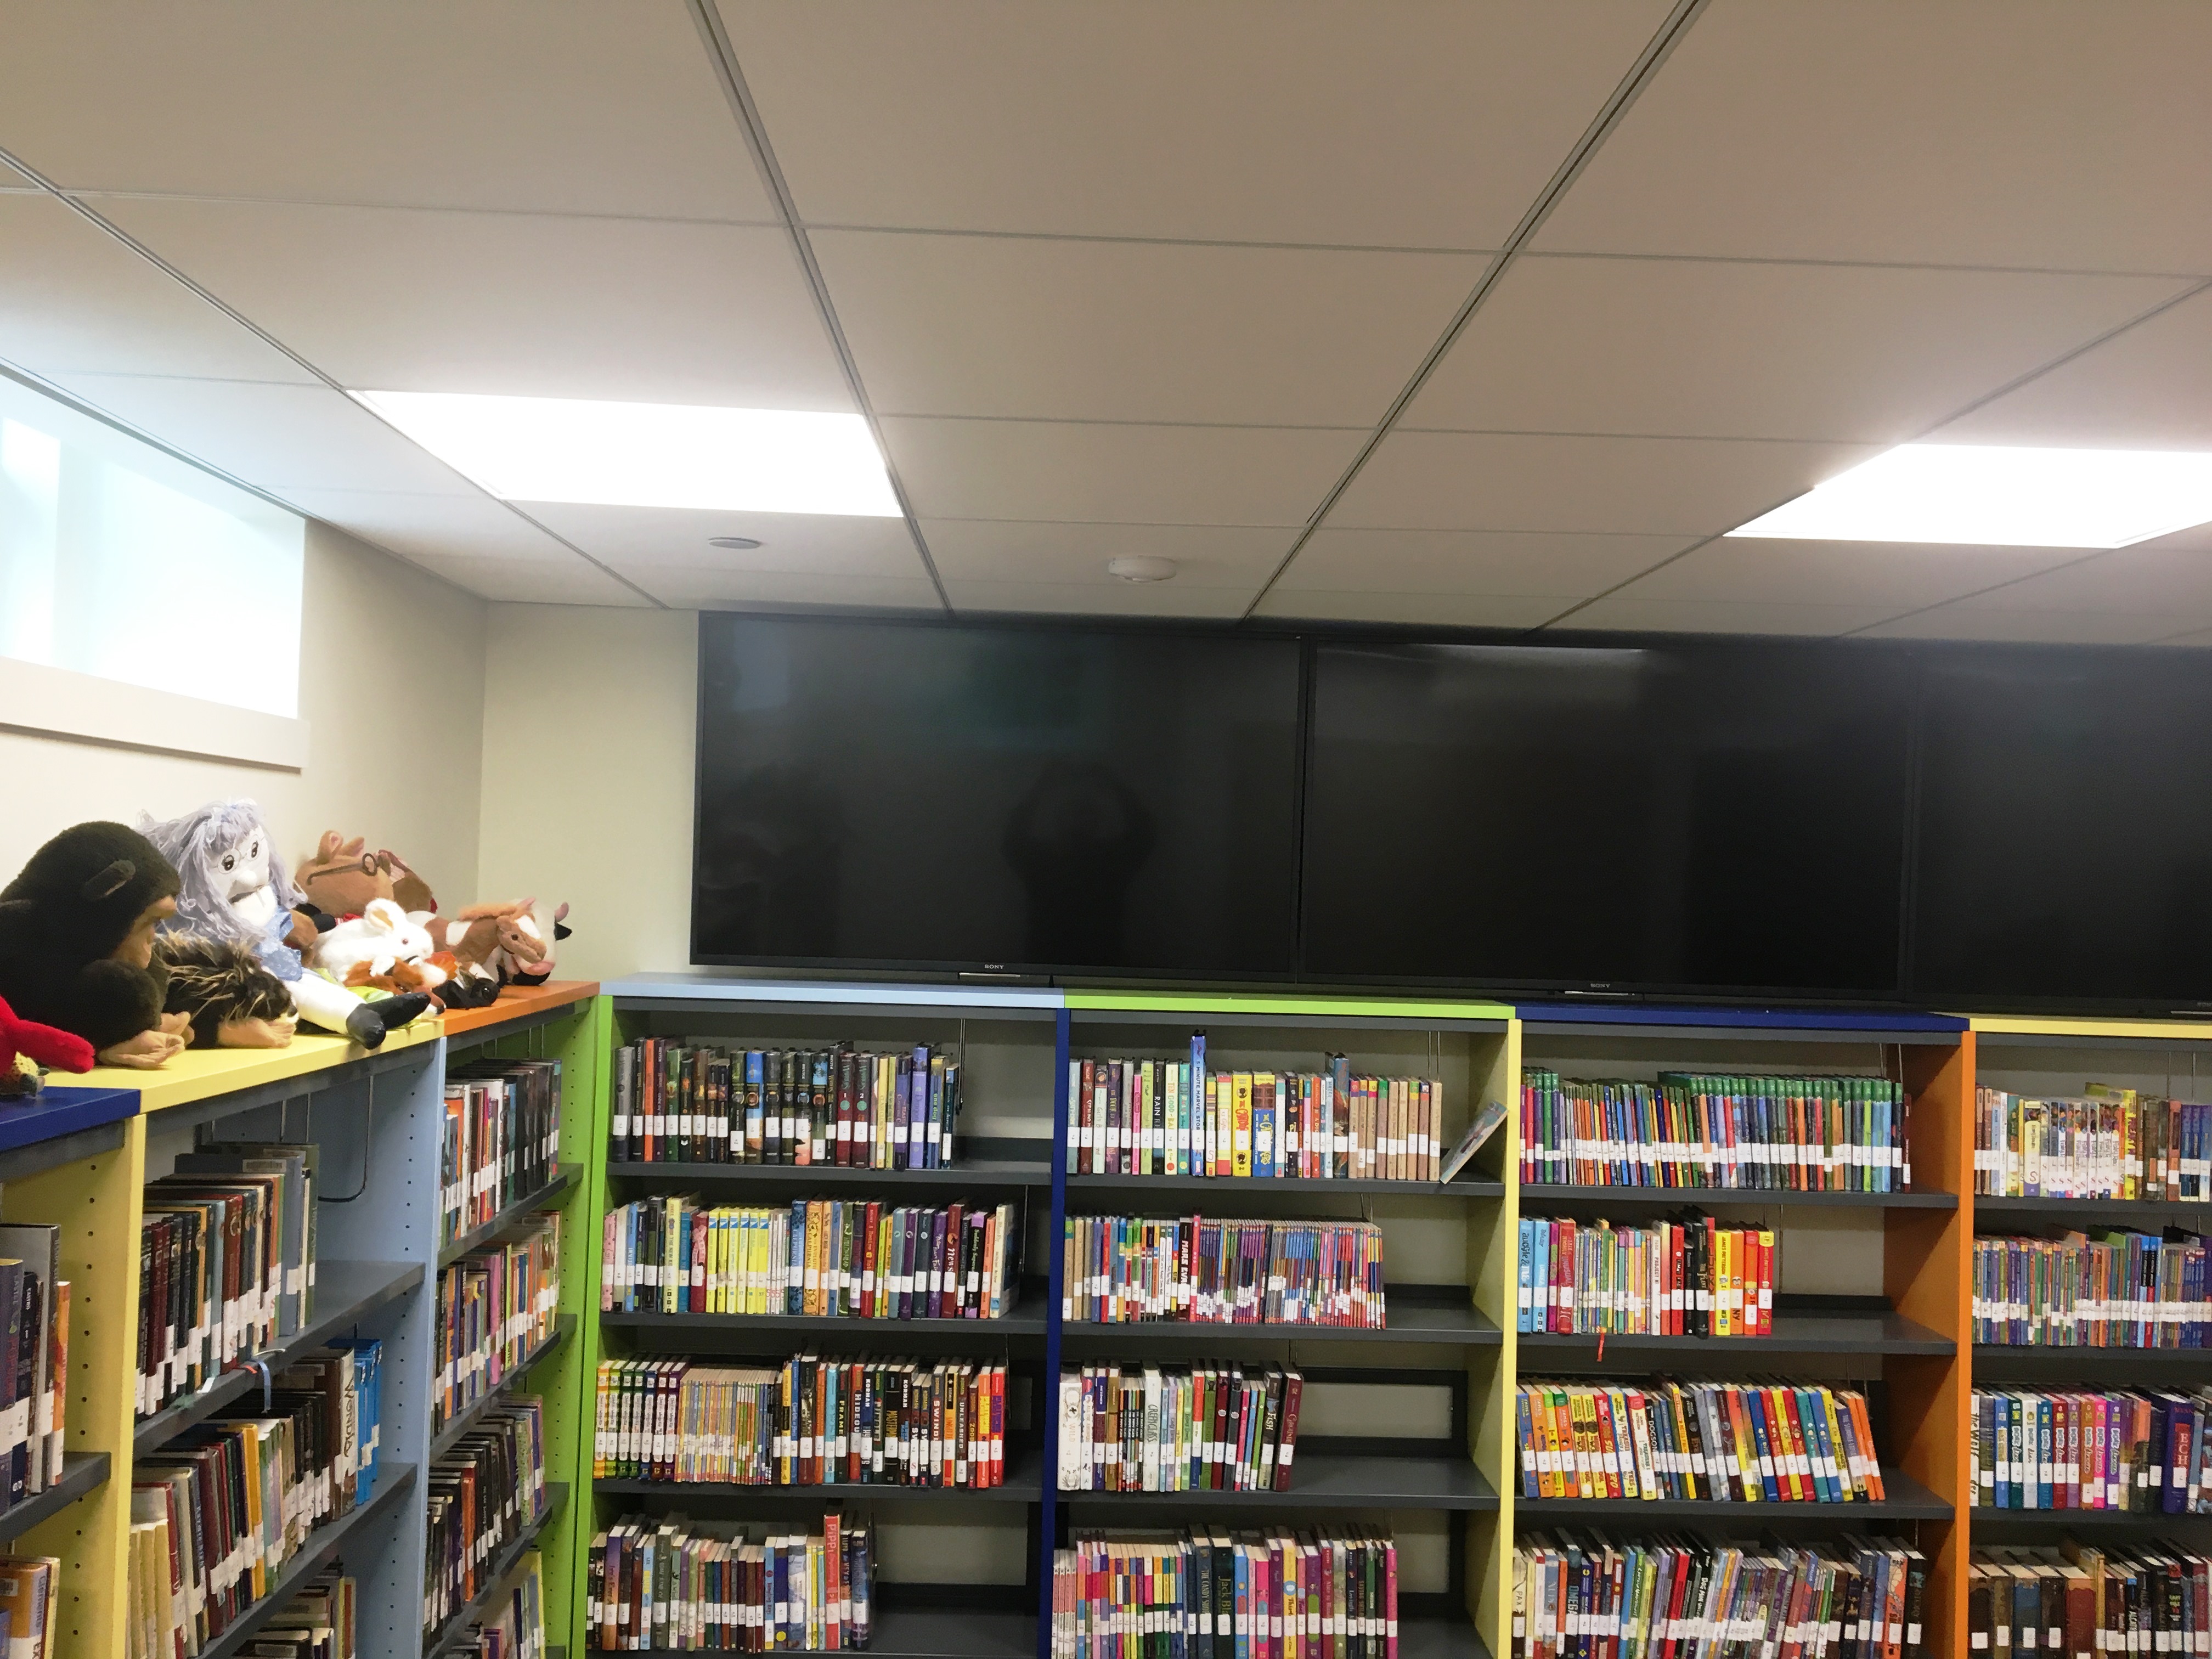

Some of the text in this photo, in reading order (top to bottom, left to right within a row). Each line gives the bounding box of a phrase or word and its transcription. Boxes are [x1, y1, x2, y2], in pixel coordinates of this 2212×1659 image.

[947, 1248, 956, 1272] News
[343, 1378, 356, 1458] WONDLA
[854, 1393, 862, 1432] HIDEOU
[885, 1410, 898, 1437] MASTERM
[1266, 1412, 1277, 1431] FISH
[1068, 1422, 1076, 1442] WILD
[1647, 1420, 1658, 1452] DOGSON
[1970, 1413, 1979, 1458] the Wolf
[1201, 1570, 1210, 1615] THE CANDY SHOP
[1218, 1576, 1231, 1615] Jack Bla
[1567, 1585, 1579, 1615] OMEGA
[1697, 1577, 1709, 1602] DOG MAN
